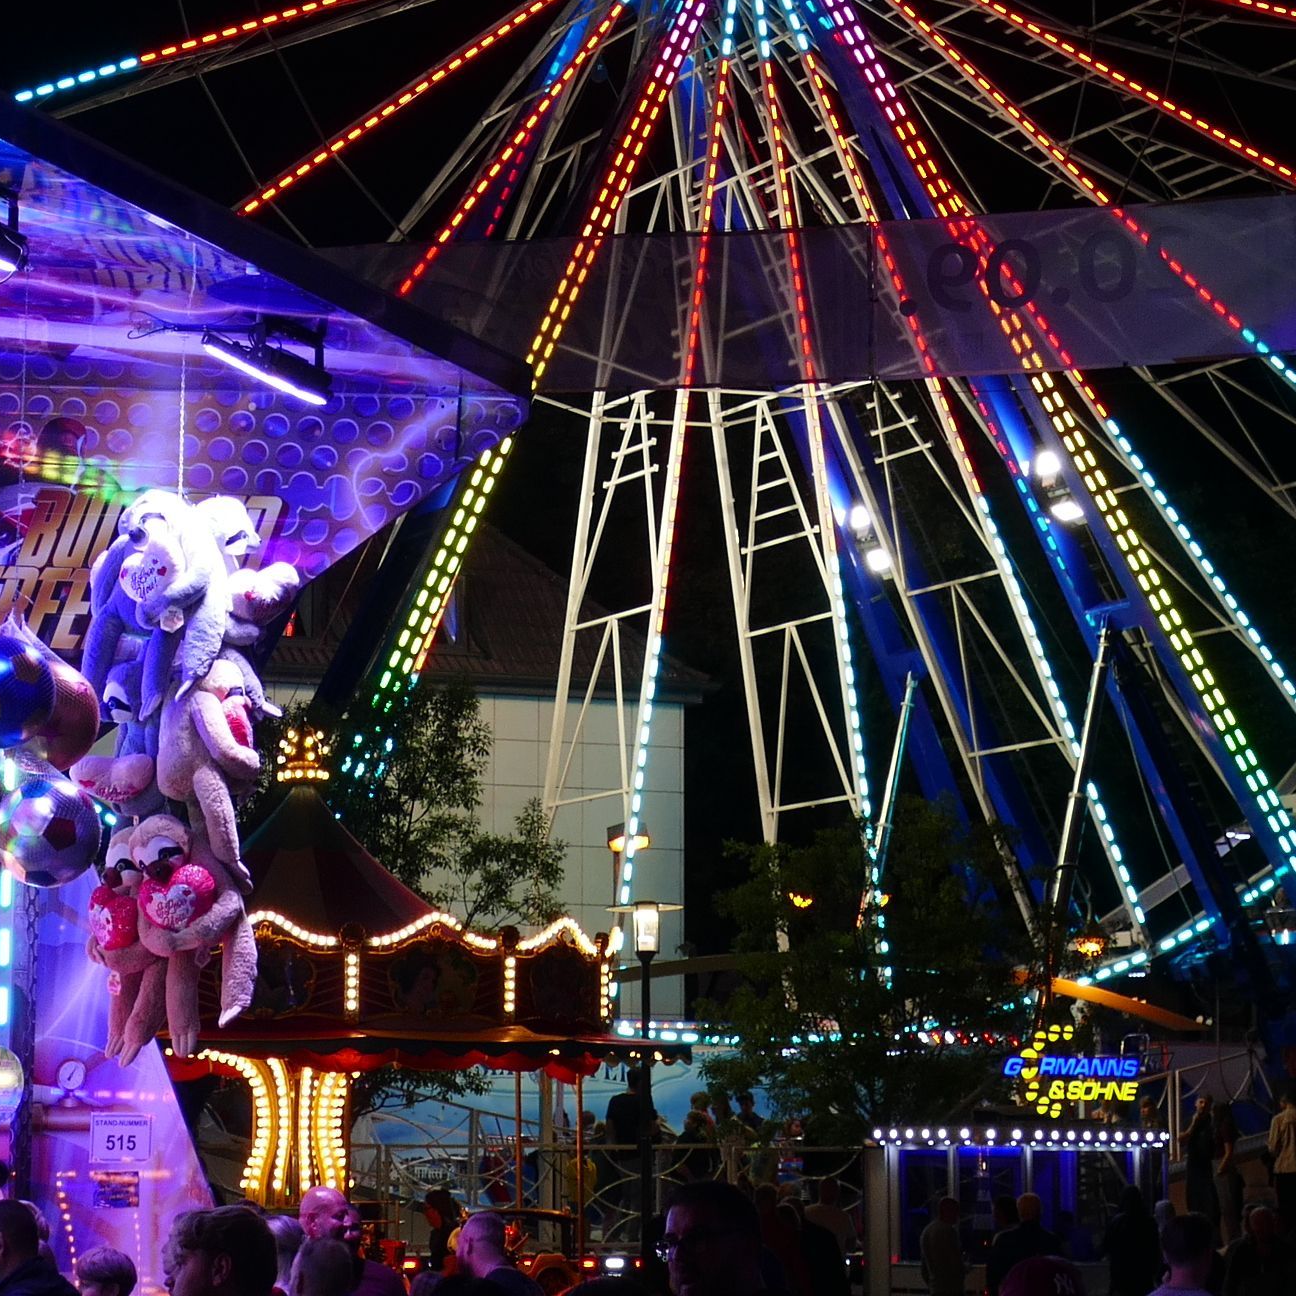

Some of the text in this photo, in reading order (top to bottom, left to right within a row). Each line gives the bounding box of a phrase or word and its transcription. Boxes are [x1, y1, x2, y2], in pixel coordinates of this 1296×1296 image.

[1048, 1079, 1139, 1102] & SÖHNE
[105, 1134, 137, 1151] 515
